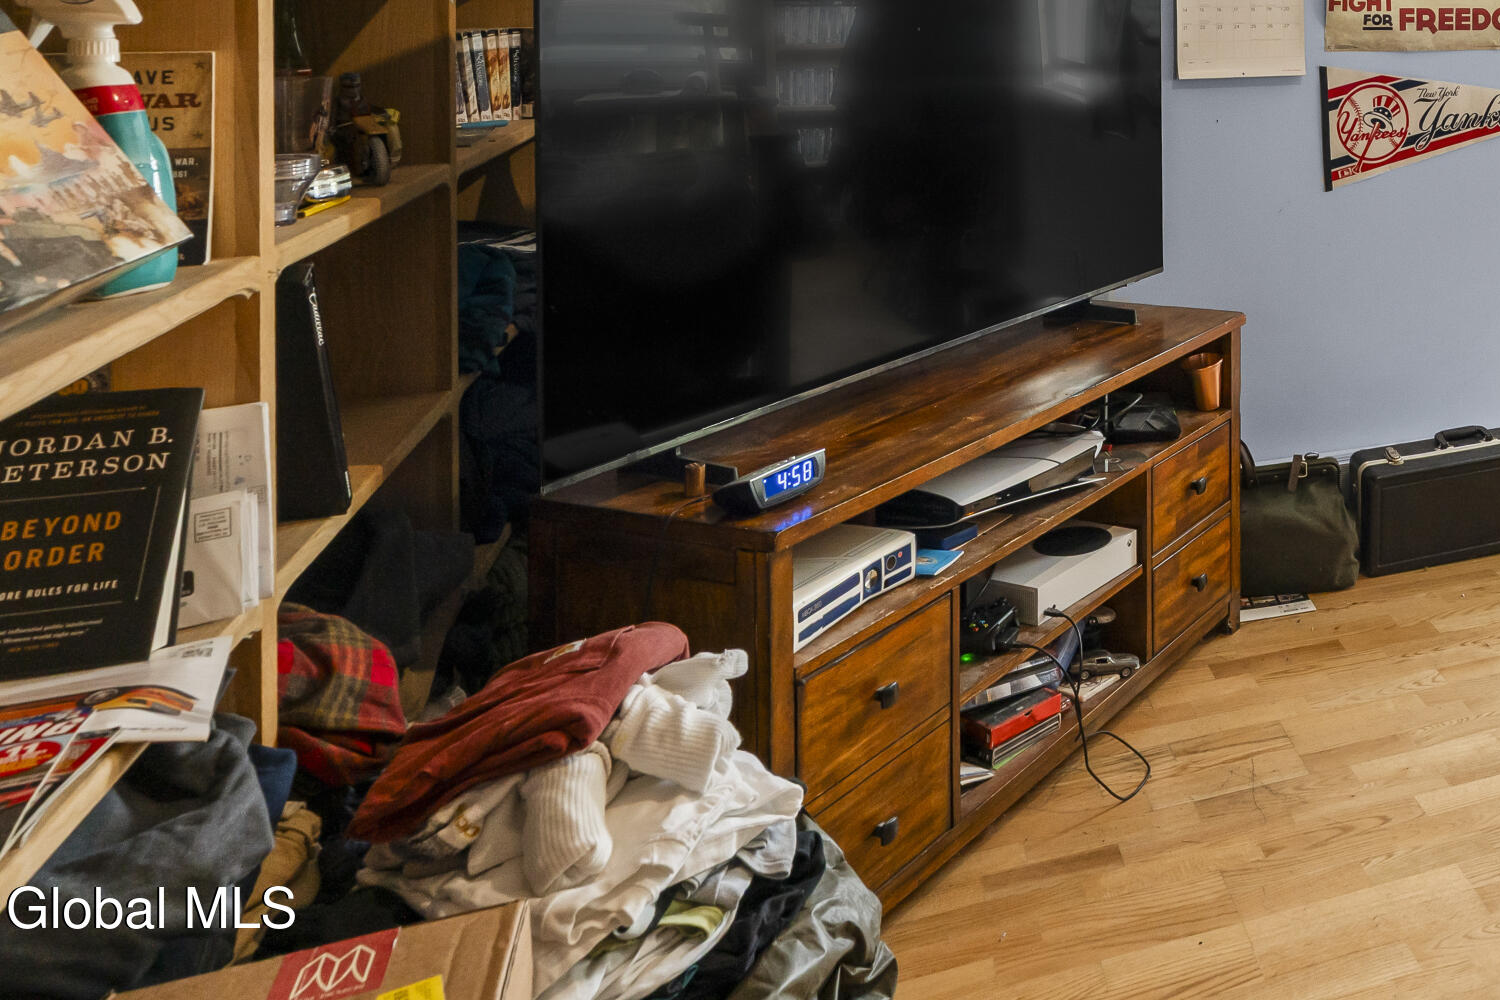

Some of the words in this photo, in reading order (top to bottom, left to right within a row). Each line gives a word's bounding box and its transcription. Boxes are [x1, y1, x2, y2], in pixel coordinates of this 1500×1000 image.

[1363, 13, 1394, 26] FOR
[134, 69, 175, 85] AVE
[1416, 86, 1438, 99] New
[1437, 85, 1461, 102] York
[1337, 110, 1408, 146] Yankees
[148, 427, 174, 445] B.
[1, 452, 171, 485] ETERSON
[777, 460, 812, 490] 4:58
[1, 511, 122, 541] BEYOND
[3, 542, 105, 571] ORDER
[0, 590, 22, 601] ORE
[26, 585, 63, 599] RULES
[66, 582, 89, 594] FOR
[93, 579, 119, 591] LIFE
[0, 716, 87, 746] ING
